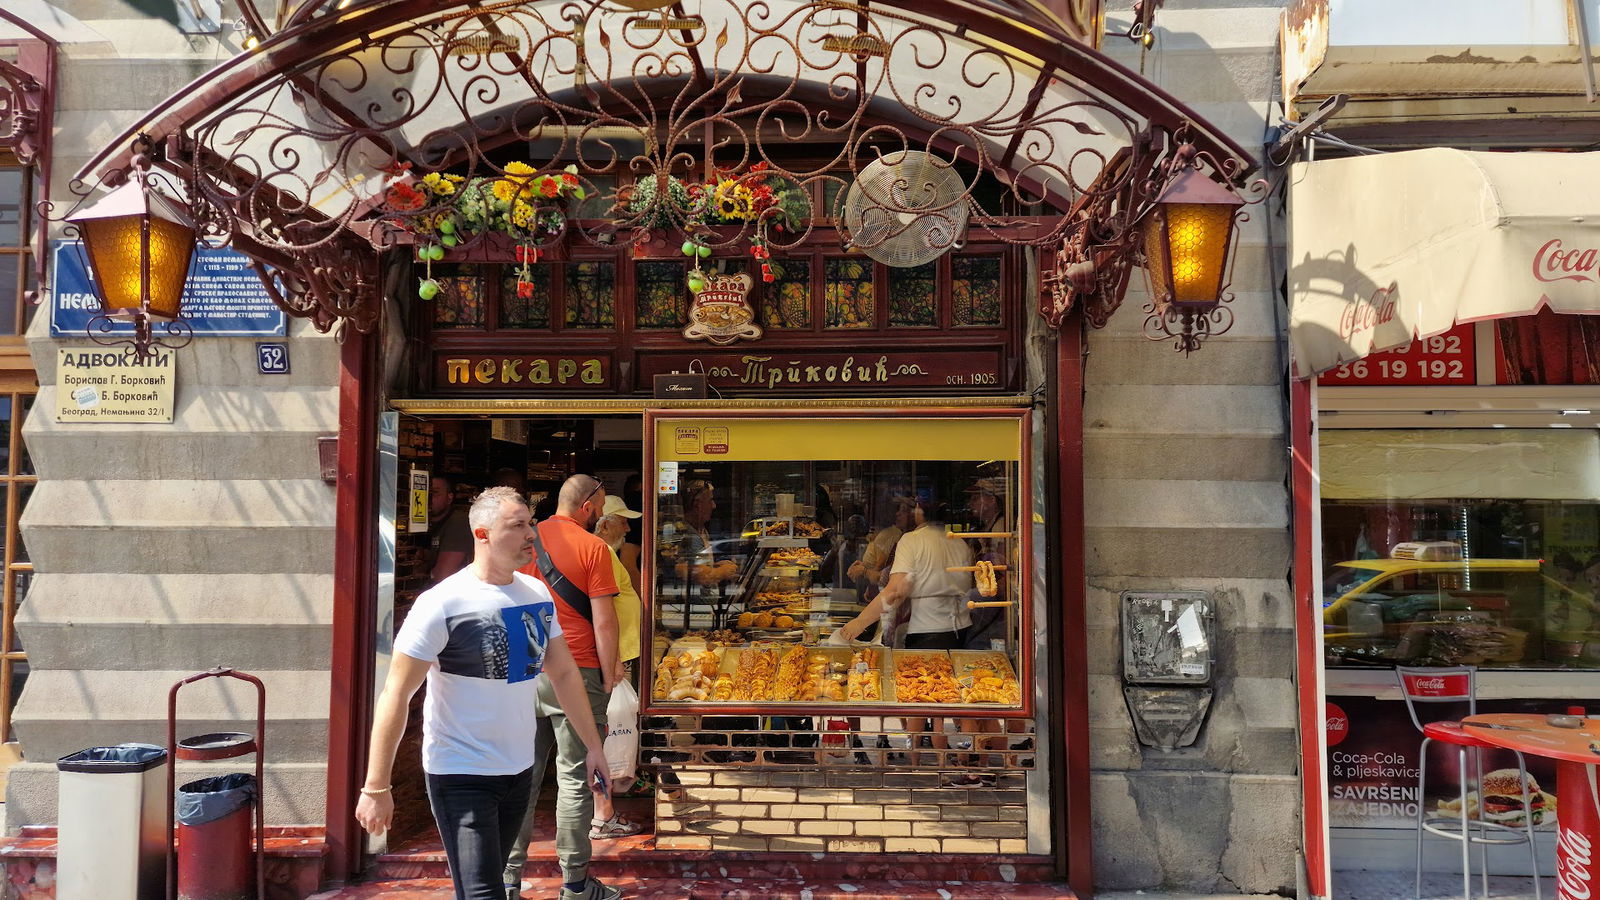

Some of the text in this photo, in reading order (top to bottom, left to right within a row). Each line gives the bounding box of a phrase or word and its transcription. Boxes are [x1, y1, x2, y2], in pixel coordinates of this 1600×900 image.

[1421, 335, 1462, 354] 192
[63, 352, 169, 369] АДВОКАТИ
[261, 347, 284, 369] 32
[1335, 360, 1464, 379] 36 19 192
[64, 374, 166, 388] Борислав Г. Борковић
[101, 390, 110, 401] Б.
[113, 390, 158, 404] Борковић
[61, 407, 98, 417] Београд,
[100, 407, 145, 416] Немањина
[1332, 751, 1405, 764] Coca-Cola
[1332, 764, 1420, 779] & pljeskavica
[1333, 783, 1419, 801] SAVRŠENI
[1334, 801, 1419, 817] ZAJEDNO
